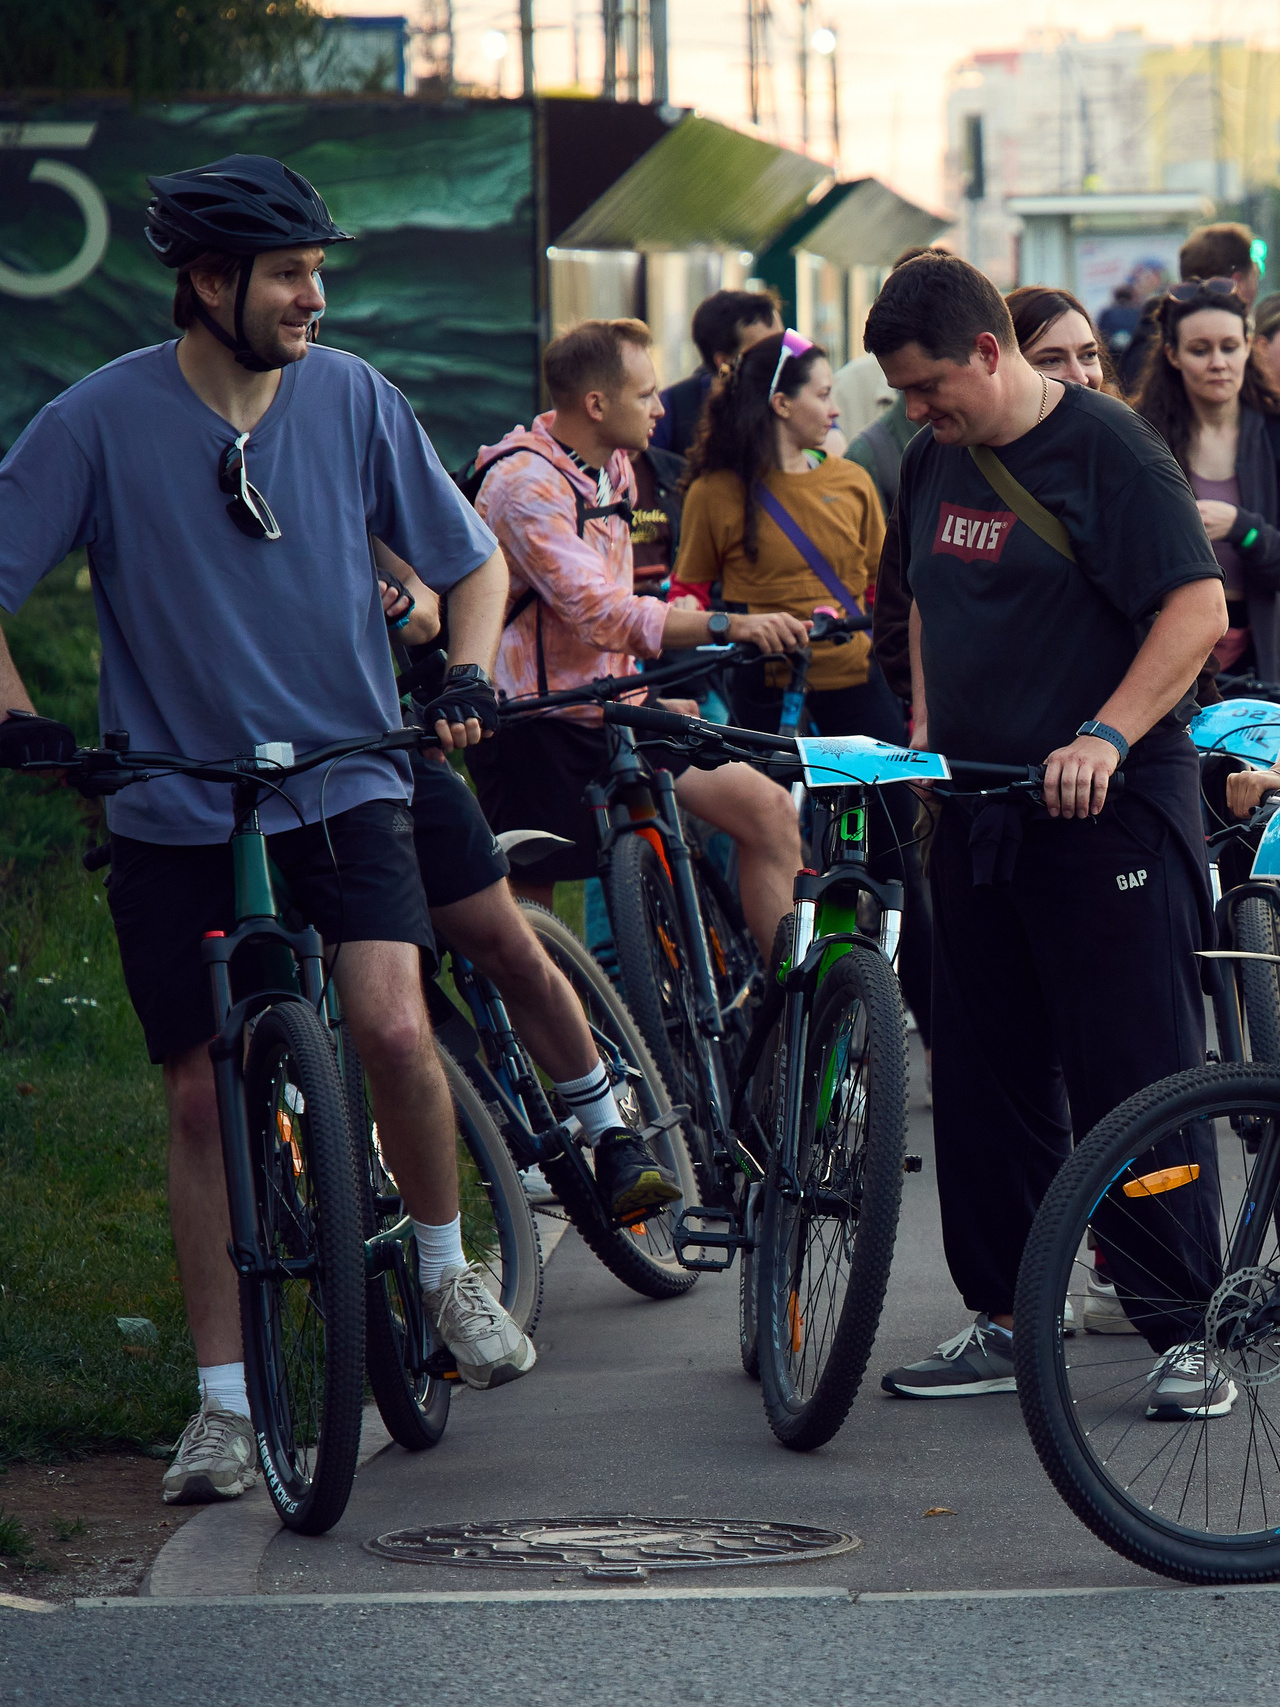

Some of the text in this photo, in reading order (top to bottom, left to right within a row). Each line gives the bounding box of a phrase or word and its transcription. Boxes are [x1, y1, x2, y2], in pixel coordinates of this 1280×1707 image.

[1116, 869, 1147, 890] GAP
[257, 1431, 280, 1488] RABBIT
[274, 1483, 292, 1508] JACK
